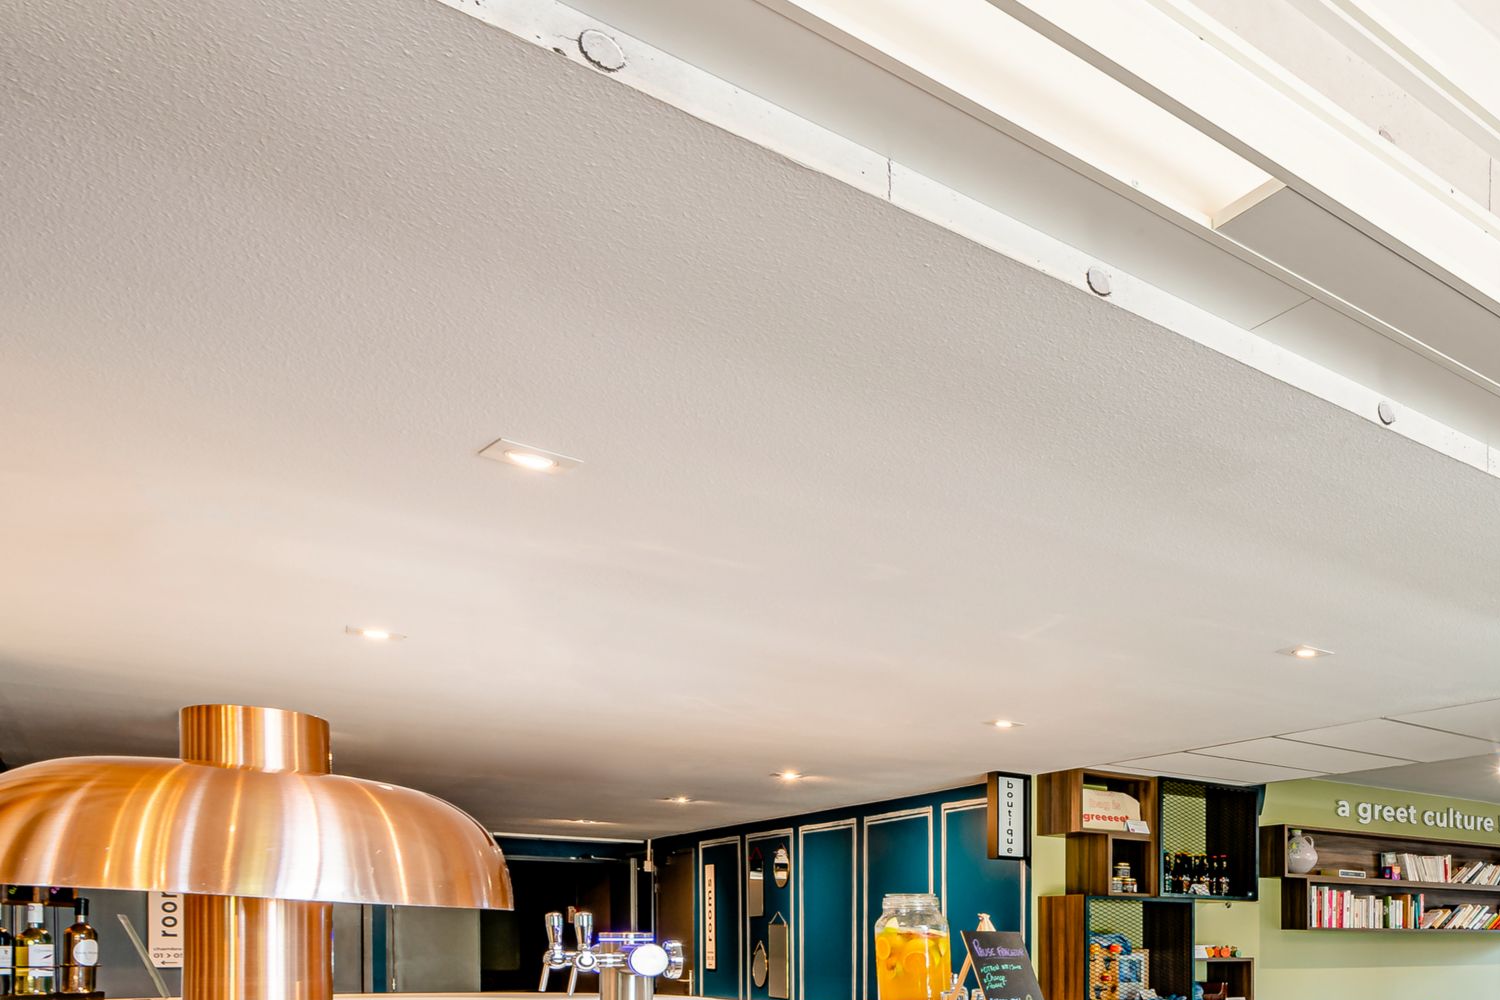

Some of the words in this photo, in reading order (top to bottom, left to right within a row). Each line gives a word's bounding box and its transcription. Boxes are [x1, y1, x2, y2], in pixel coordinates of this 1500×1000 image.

[1006, 780, 1015, 854] boutique
[1336, 799, 1350, 817] a
[1357, 799, 1418, 825] greet
[1423, 807, 1495, 833] culture
